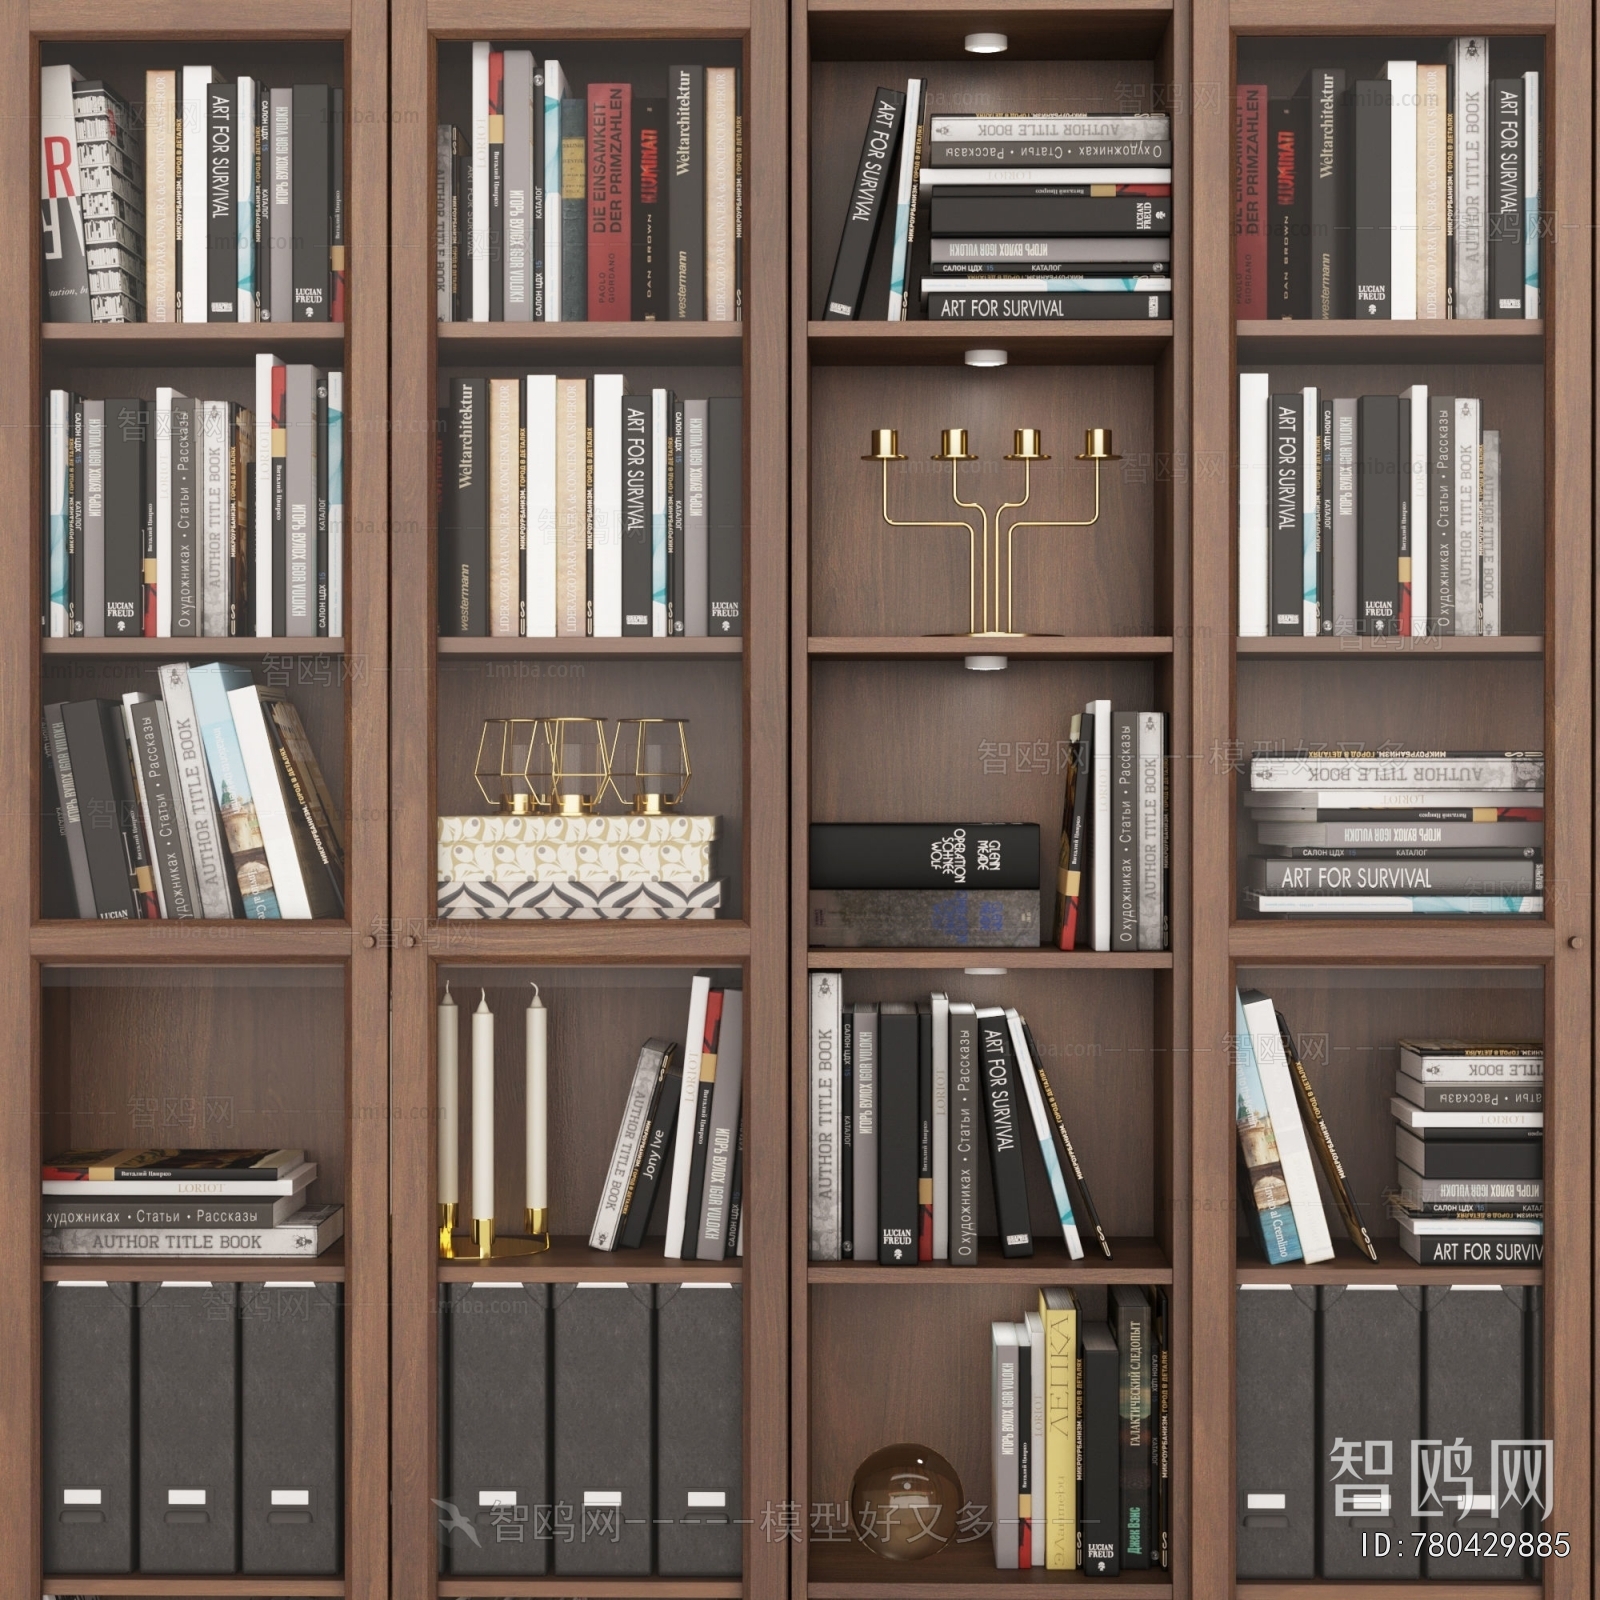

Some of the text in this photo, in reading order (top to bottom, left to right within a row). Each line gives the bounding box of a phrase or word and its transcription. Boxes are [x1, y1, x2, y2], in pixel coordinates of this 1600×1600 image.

[677, 71, 690, 175] Weltarchitektur
[978, 125, 1119, 136] AUTHOR TITLE BOOK
[1320, 74, 1335, 177] Weltarchitektur
[1466, 92, 1479, 134] BOOK
[213, 96, 229, 218] ART FOR SURVIVAL
[592, 102, 606, 233] DIE EINSAMKEIT
[607, 89, 623, 232] DER PRIMZAHLEN
[853, 101, 895, 220] ART FOR SURVIVAL
[946, 142, 1161, 159] О художниках Статьи Рассказы
[1466, 141, 1479, 190] TITLE
[679, 251, 687, 317] westermann
[941, 300, 1063, 316] ART FOR SURVIVAL
[1359, 292, 1385, 300] FREUD
[457, 385, 472, 488] Weltarchitektur
[1279, 407, 1296, 529] ART FOR SURVIVAL
[1437, 410, 1452, 626] О художниках Статьи Рассказы
[1460, 445, 1472, 587] AUTHOR TITLE BOOK
[292, 504, 306, 616] ИГОРЬ ВУЛОХ IGOR VULOKH
[712, 609, 739, 617] FREUD
[143, 717, 172, 836] Статьи Рассказы
[179, 718, 218, 886] AUTHOR TITLE BOOK
[931, 842, 942, 870] WOLF
[942, 837, 954, 874] SCHNEE
[954, 828, 966, 882] OPERATION
[978, 840, 989, 870] MEADE
[989, 840, 1001, 870] GLENN
[1119, 726, 1134, 941] О художниках Статьи Рассказы
[1303, 849, 1344, 857] САЛОН ЦДХ
[1345, 828, 1441, 841] ИГОРЬ ВУЛОХ IGOR VULOKH
[1281, 867, 1431, 888] ART FOR SURVIVAL
[985, 1030, 1013, 1151] ART FOR SURVIVAL
[1469, 1065, 1503, 1076] BOOK
[819, 1029, 832, 1200] AUTHOR TITLE BOOK
[1440, 1094, 1498, 1105] Рассказы
[605, 1093, 646, 1211] AUTHOR TITLE BOOK
[643, 1130, 664, 1180] Jony Ive
[178, 1183, 225, 1193] LORIOT
[705, 1127, 730, 1239] ИГОРЬ ВУЛОХ IGOR VULOKH
[1440, 1184, 1539, 1197] ИГОРЬ ВУЛОХ IGOR VULOKH
[47, 1210, 257, 1227] художниках Статьи Рассказы
[93, 1235, 261, 1248] AUTHOR TITLE BOOK
[1433, 1243, 1491, 1260] ART FOR
[1128, 1321, 1142, 1446] ГАЛАКТИЧЕСКИЙ СЛЕДОПЫТ
[1127, 1507, 1142, 1554] Джек Вэнс
